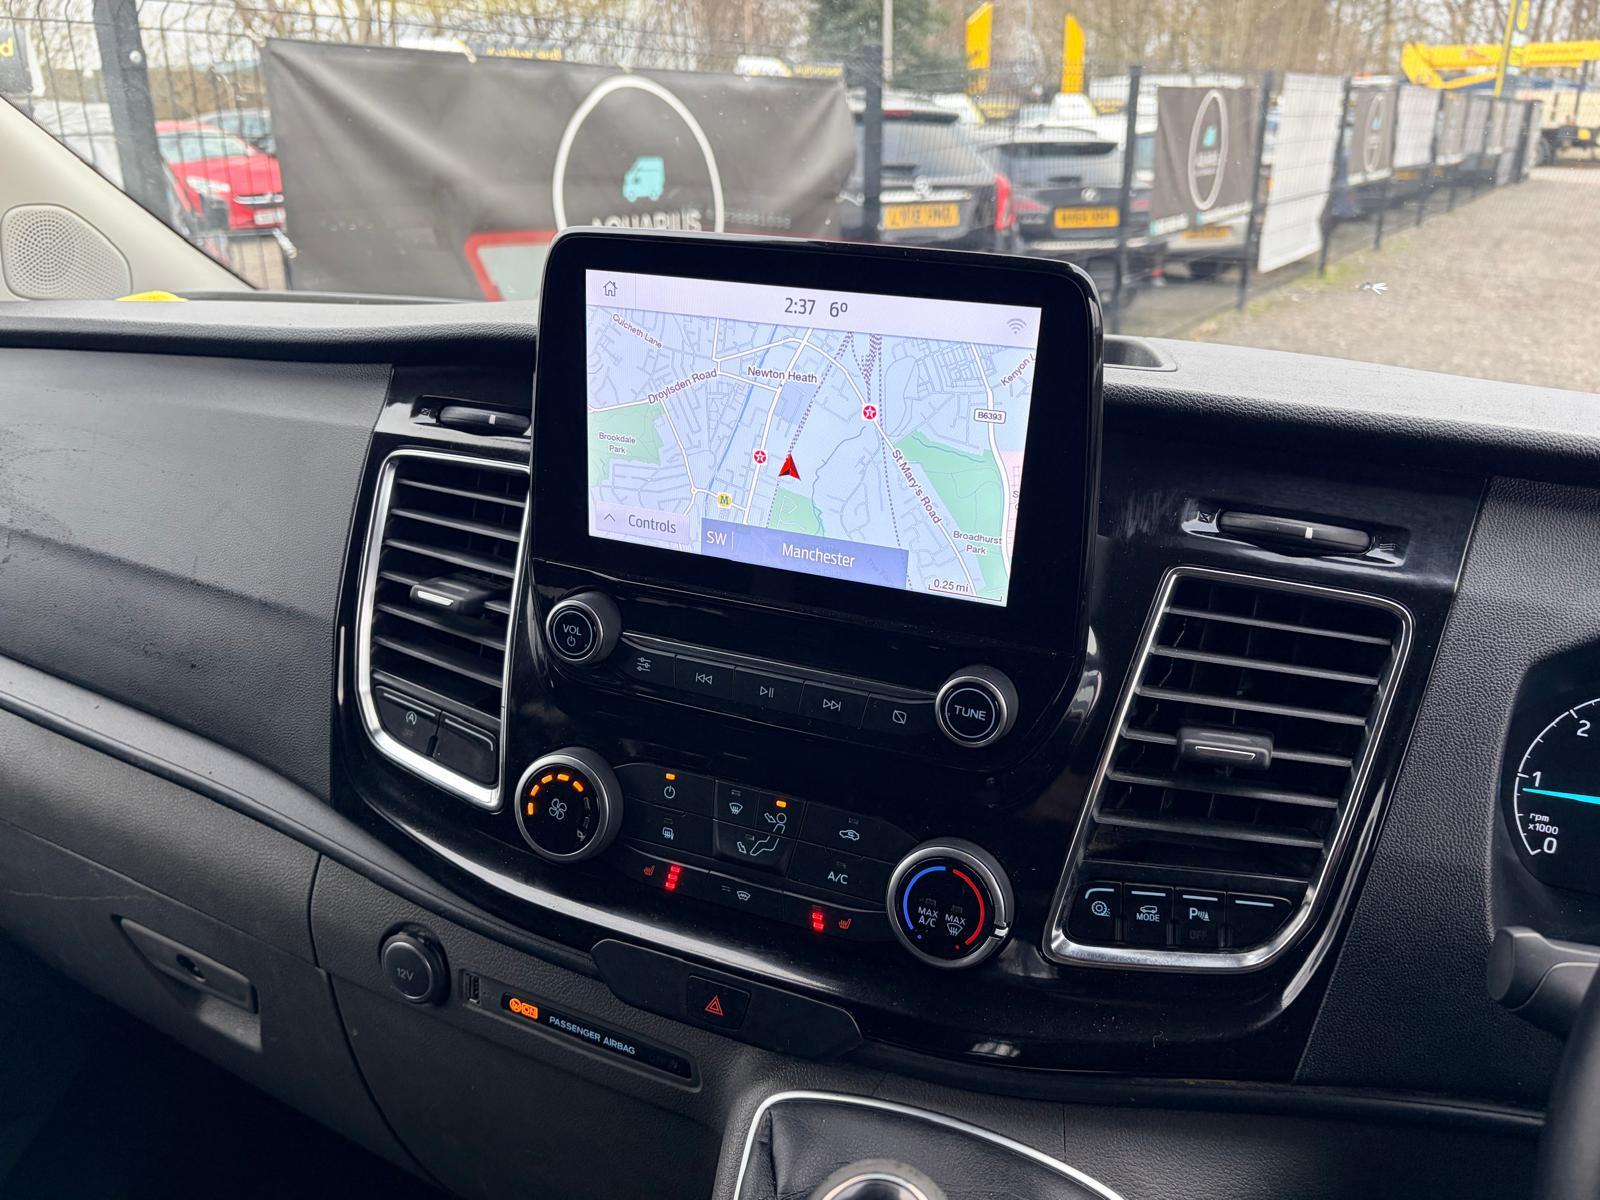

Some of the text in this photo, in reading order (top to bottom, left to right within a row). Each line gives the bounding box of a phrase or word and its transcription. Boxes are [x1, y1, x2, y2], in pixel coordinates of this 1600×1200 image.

[784, 297, 816, 315] 2:37
[612, 313, 663, 349] Culcheth Lane
[747, 366, 818, 384] Newton Heath
[1000, 358, 1030, 386] Kenyon
[647, 367, 718, 405] Droylsden Road
[977, 411, 1003, 422] B6393
[598, 432, 636, 445] Brookdale
[609, 444, 627, 454] Park
[892, 449, 942, 525] St Mary's Road
[628, 513, 677, 534] Controls
[706, 530, 727, 546] SW
[953, 530, 1003, 546] Broadhurst
[782, 543, 857, 569] Manchester
[966, 543, 987, 556] Park
[933, 578, 969, 593] 0.25 mi
[563, 624, 582, 636] VOL
[954, 705, 987, 721] TUNE
[1577, 719, 1591, 738] 2
[1533, 771, 1542, 787] 1
[1530, 812, 1549, 822] rpm
[1528, 823, 1558, 835] x1000
[1543, 836, 1558, 855] 0
[827, 871, 848, 884] A/C
[917, 906, 939, 919] MAX
[944, 913, 966, 926] MAX
[1136, 912, 1160, 922] MODE
[918, 915, 936, 928] A/C
[396, 967, 414, 980] 12V
[523, 1005, 537, 1017] ON
[549, 1015, 637, 1056] PASSENGER AIRBAG
